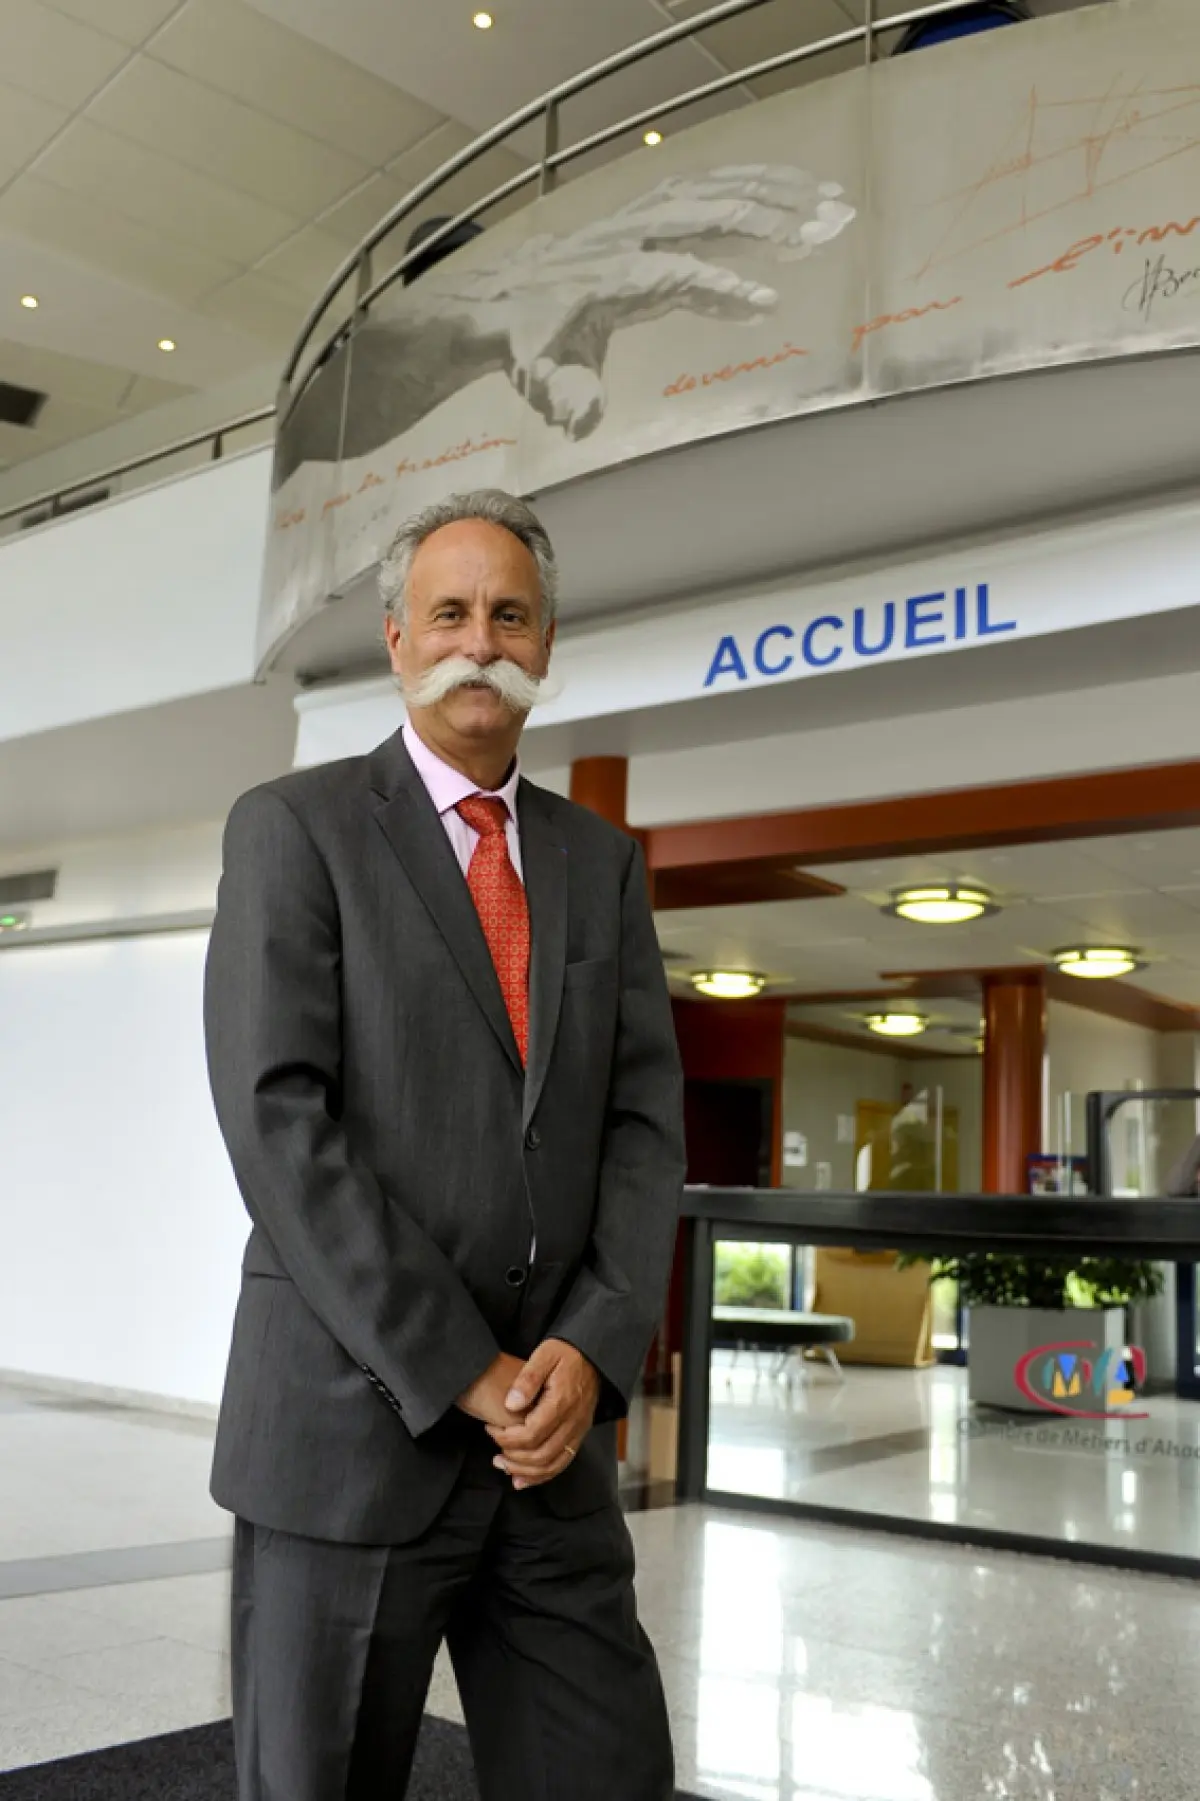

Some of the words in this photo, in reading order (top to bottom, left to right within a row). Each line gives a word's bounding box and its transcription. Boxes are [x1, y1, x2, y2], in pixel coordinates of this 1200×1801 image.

[662, 342, 808, 397] devenir
[850, 296, 963, 355] par
[703, 583, 1017, 688] ACCUEIL
